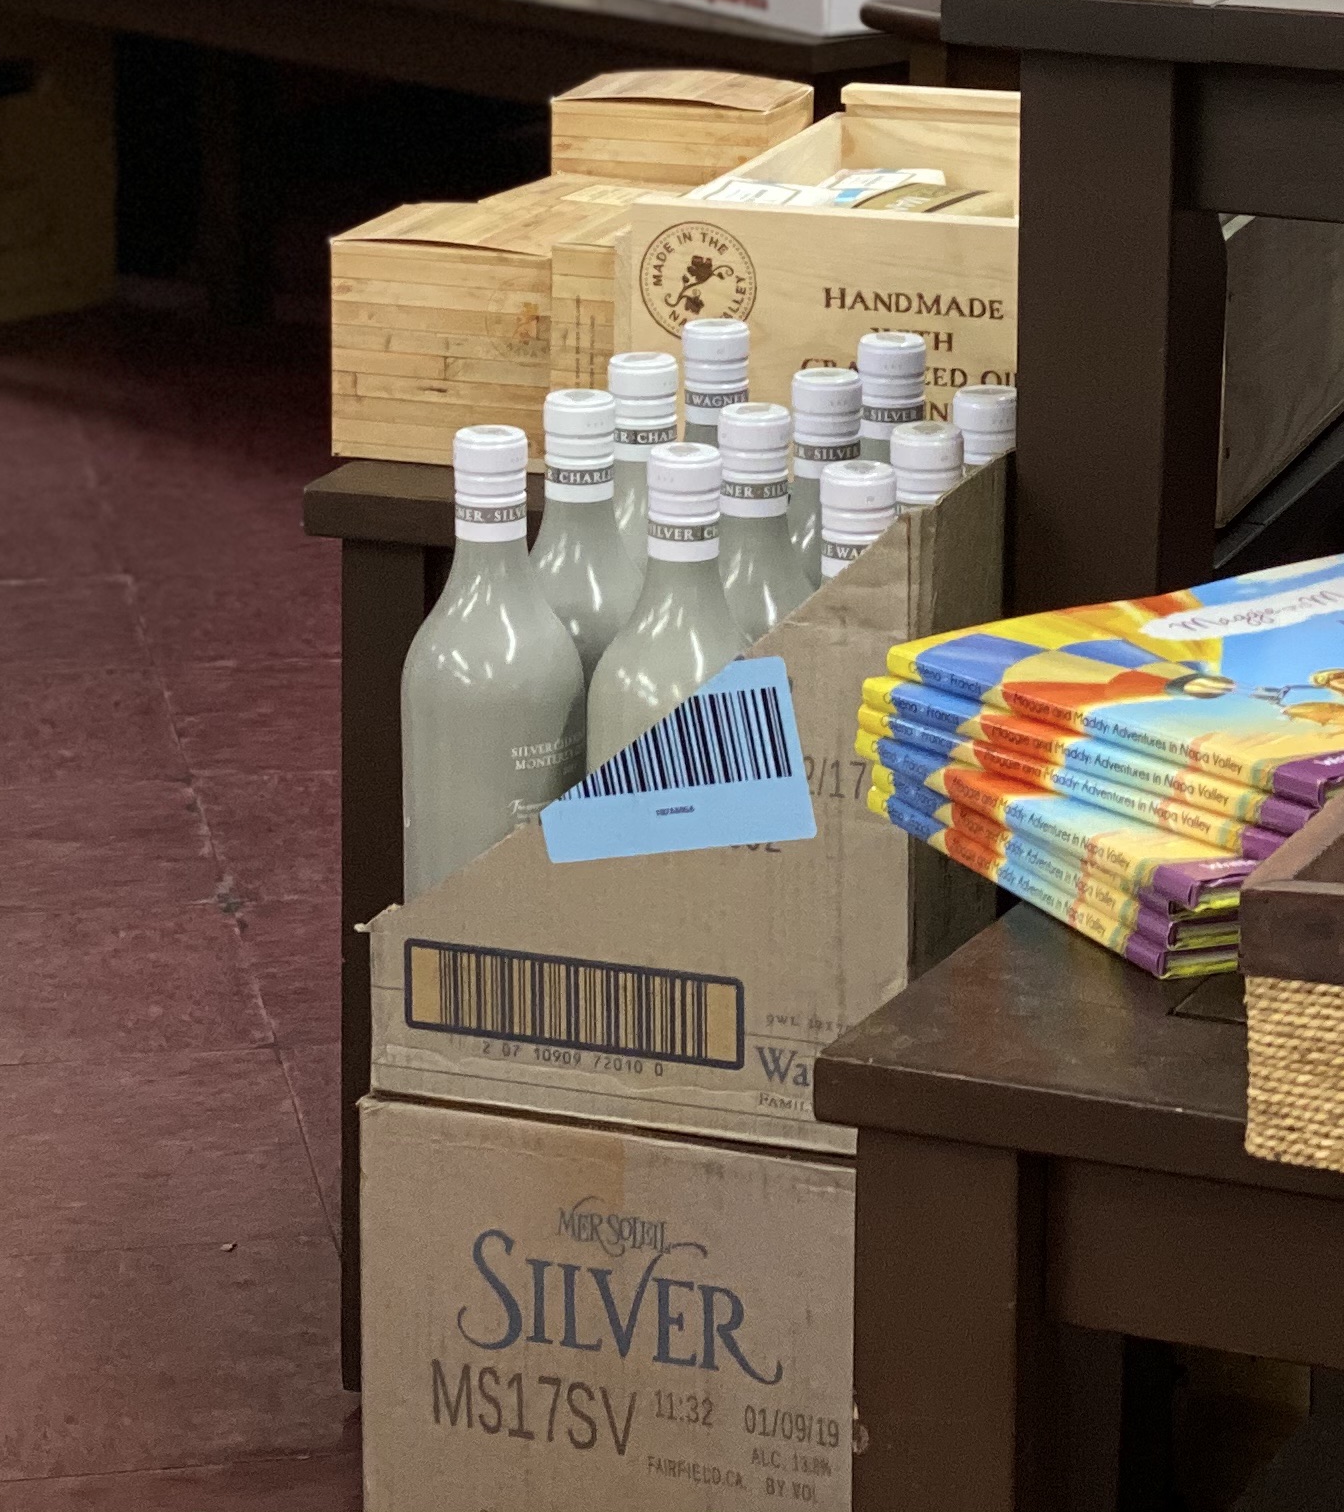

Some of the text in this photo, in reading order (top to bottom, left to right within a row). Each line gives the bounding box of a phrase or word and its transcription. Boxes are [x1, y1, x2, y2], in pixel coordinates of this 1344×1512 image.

[652, 231, 730, 287] MADE IN THE
[720, 274, 747, 319] ALLEY
[823, 286, 1005, 321] HANDMADE
[869, 408, 918, 422] SILVER
[1012, 693, 1052, 719] Maggie
[1053, 707, 1072, 723] and
[1073, 709, 1110, 734] Maddy:
[1112, 723, 1167, 753] Adventures
[1168, 740, 1178, 754] in
[1179, 742, 1211, 767] Napa
[1211, 751, 1244, 776] Valley
[1022, 764, 1042, 778] and
[1081, 779, 1136, 808] Adventures
[1137, 796, 1148, 810] in
[1148, 798, 1179, 824] Napa
[1180, 810, 1212, 835] Valley
[1031, 738, 1054, 754] and
[1054, 741, 1092, 765] Maddy:
[1093, 753, 1151, 782] Adventures
[1152, 772, 1162, 785] in
[1163, 773, 1195, 795] Napa
[1197, 781, 1230, 807] Valley
[1027, 812, 1071, 844] Adventures
[1071, 834, 1080, 847] in
[1080, 837, 1105, 858] Napa
[1105, 846, 1132, 870] Valley
[1017, 875, 1056, 910] Adventures
[1085, 910, 1108, 936] Valley
[482, 1042, 665, 1077] 2 07 10909 72010 0
[758, 1092, 809, 1113] FAMIL
[558, 1196, 708, 1260] MER SOLEIL
[457, 1228, 784, 1385] SILVER
[431, 1358, 842, 1456] MS17SV 11:32 01/09/19
[764, 1477, 788, 1497] BY
